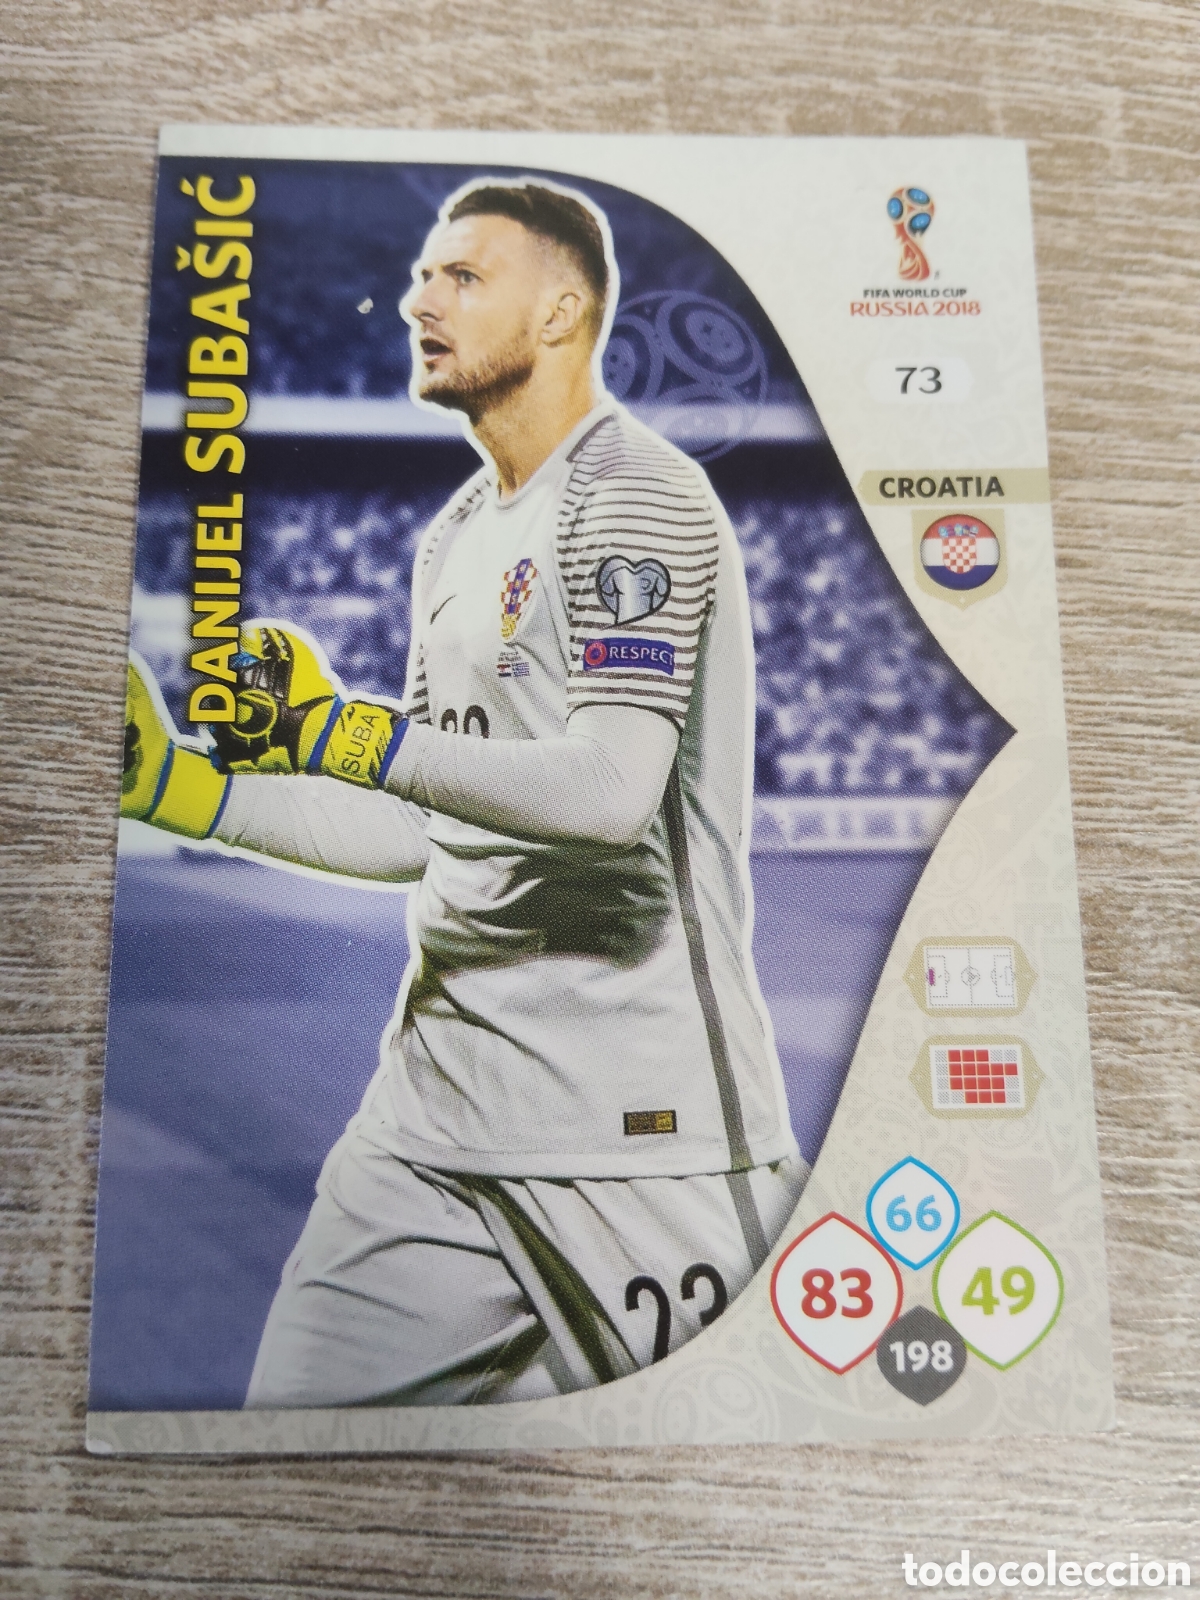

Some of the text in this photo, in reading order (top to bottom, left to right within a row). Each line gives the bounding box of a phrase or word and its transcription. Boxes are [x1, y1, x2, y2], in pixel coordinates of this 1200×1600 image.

[850, 301, 981, 316] RUSSIA 2018
[863, 289, 967, 298] FIFA WORLD CUP
[895, 367, 942, 394] 73
[175, 174, 256, 722] DANIJEL SUBAŠIĆ
[879, 476, 1005, 498] CROATIA
[341, 713, 380, 776] SUBA
[885, 1194, 942, 1232] 66
[801, 1267, 874, 1320] 83
[961, 1265, 1036, 1316] 49
[889, 1340, 954, 1373] 198
